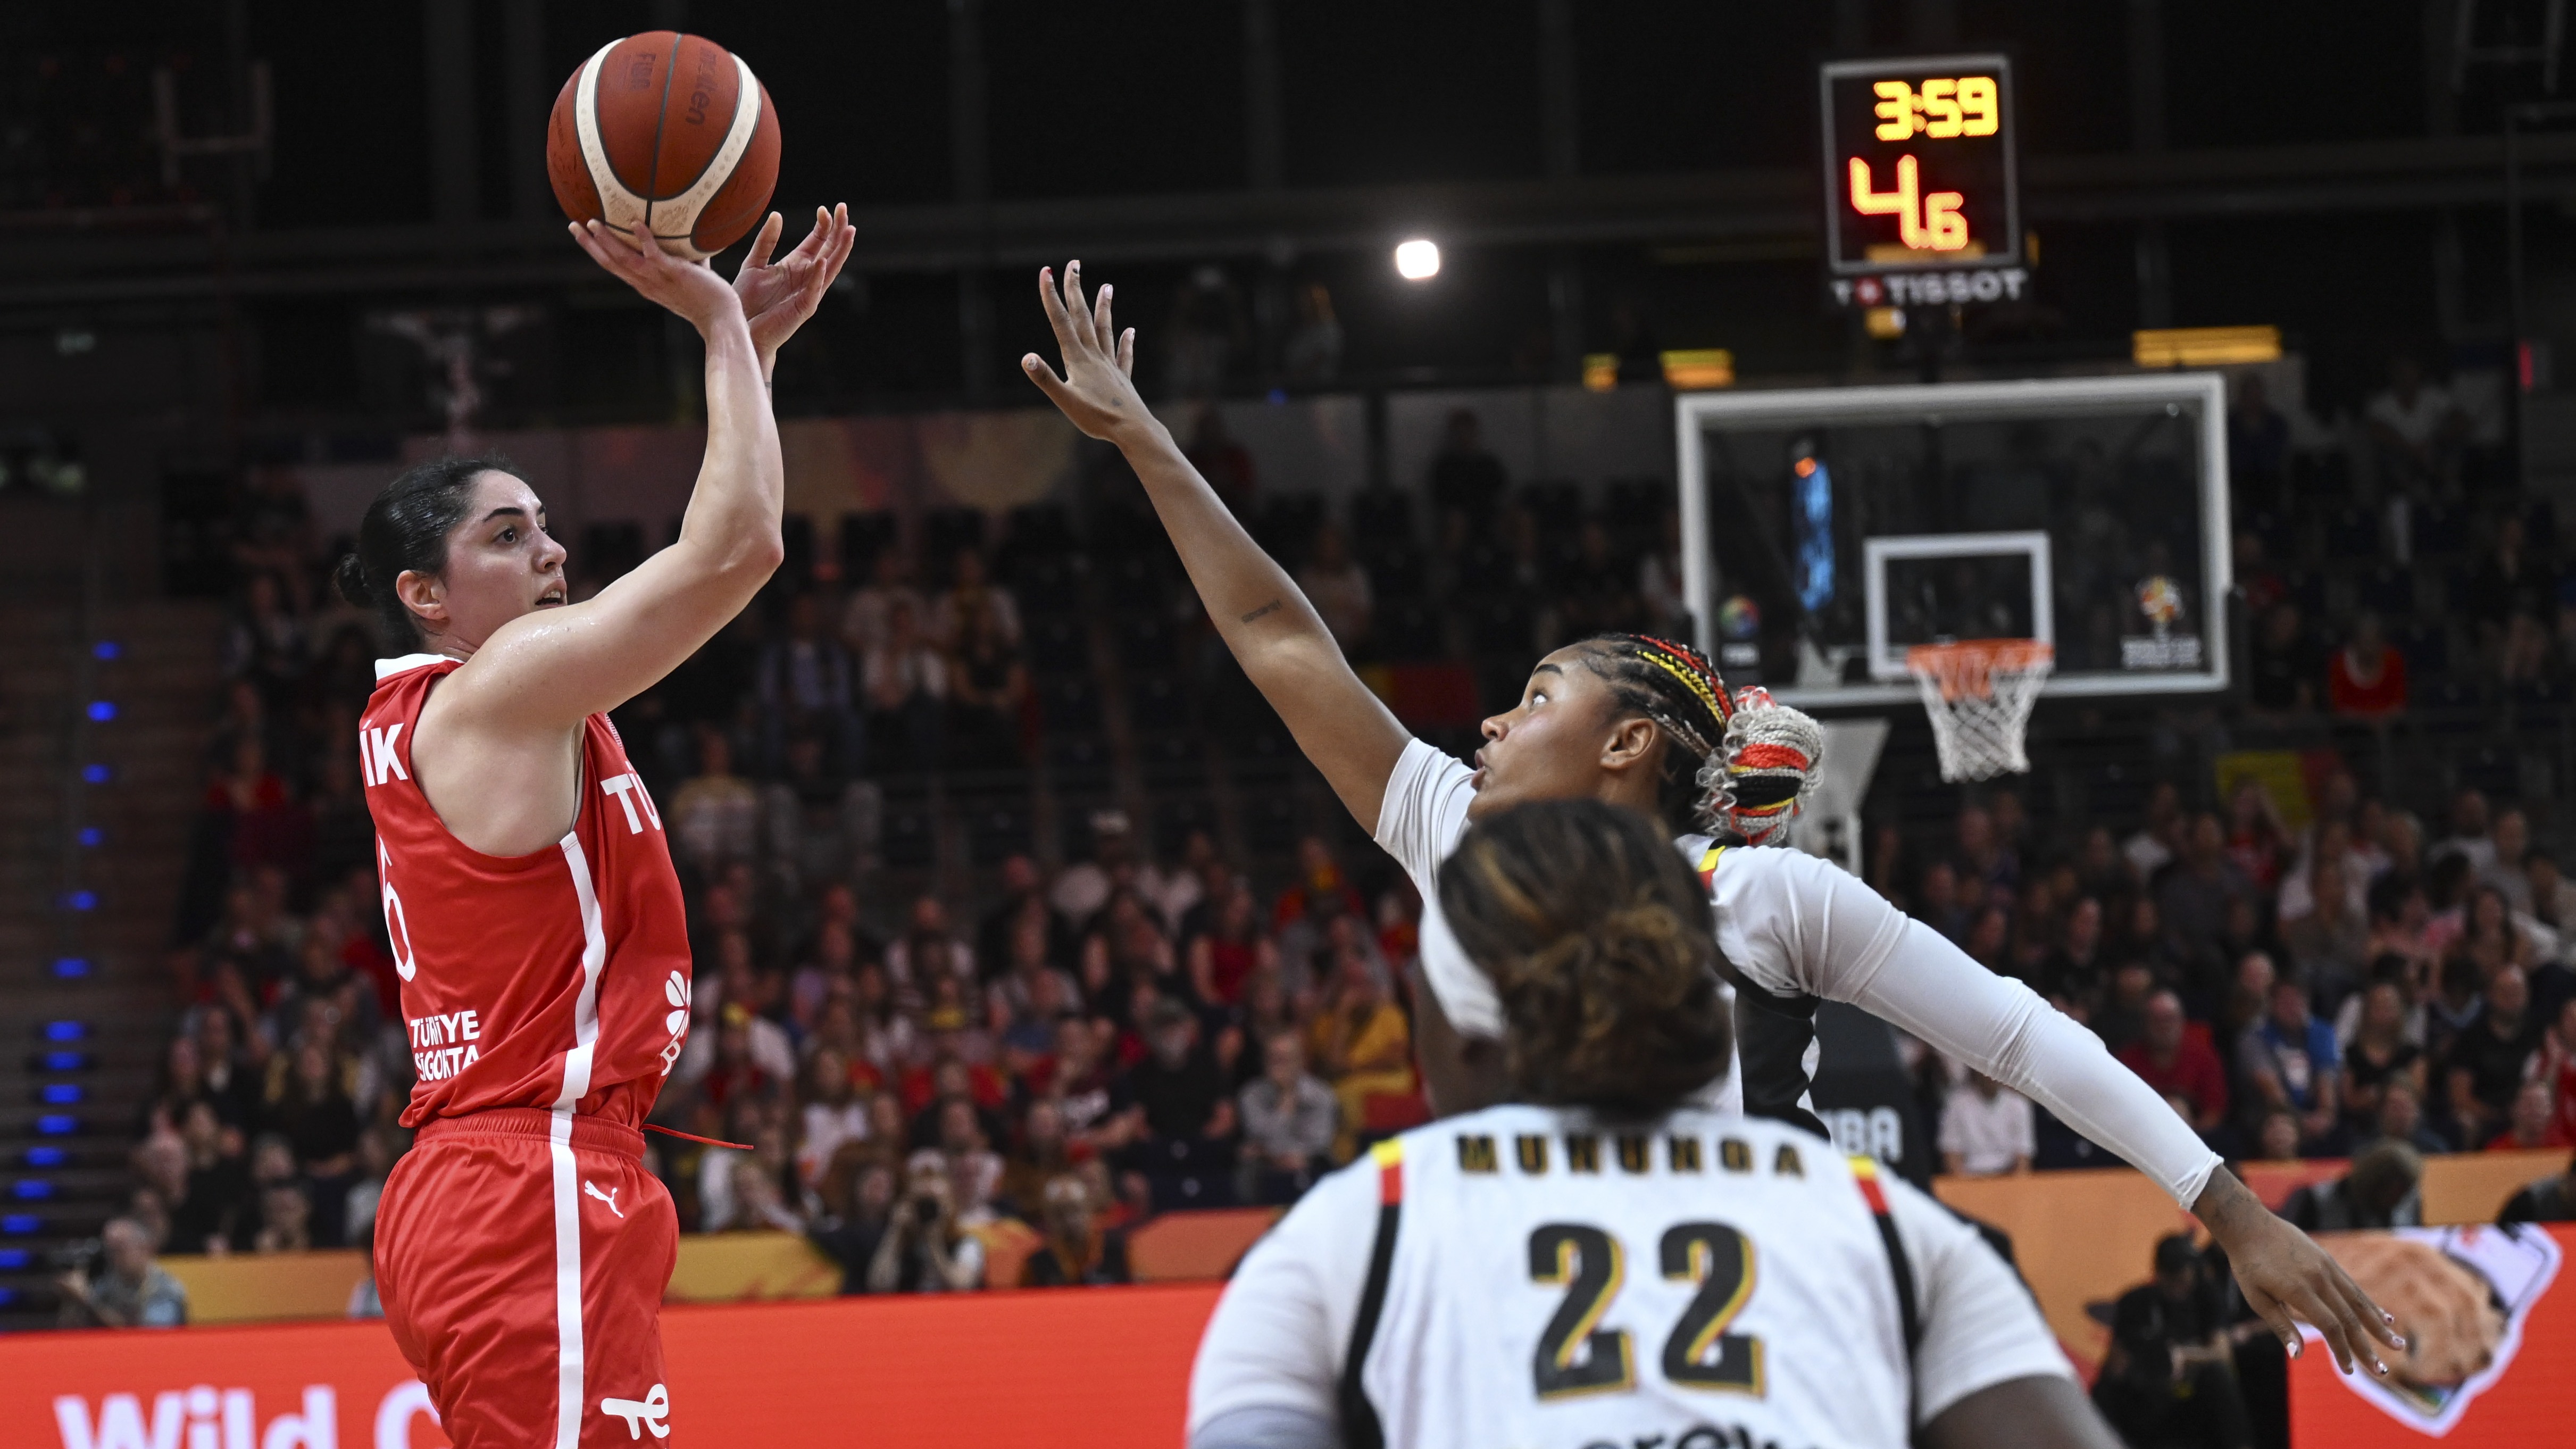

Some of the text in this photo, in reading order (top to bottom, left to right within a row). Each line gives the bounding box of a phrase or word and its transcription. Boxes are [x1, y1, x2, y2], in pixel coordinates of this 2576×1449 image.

[1873, 77, 1998, 141] 3:59
[1849, 154, 1969, 251] 4.6
[1529, 1222, 1765, 1403] 22
[54, 1384, 339, 1449] Wild
